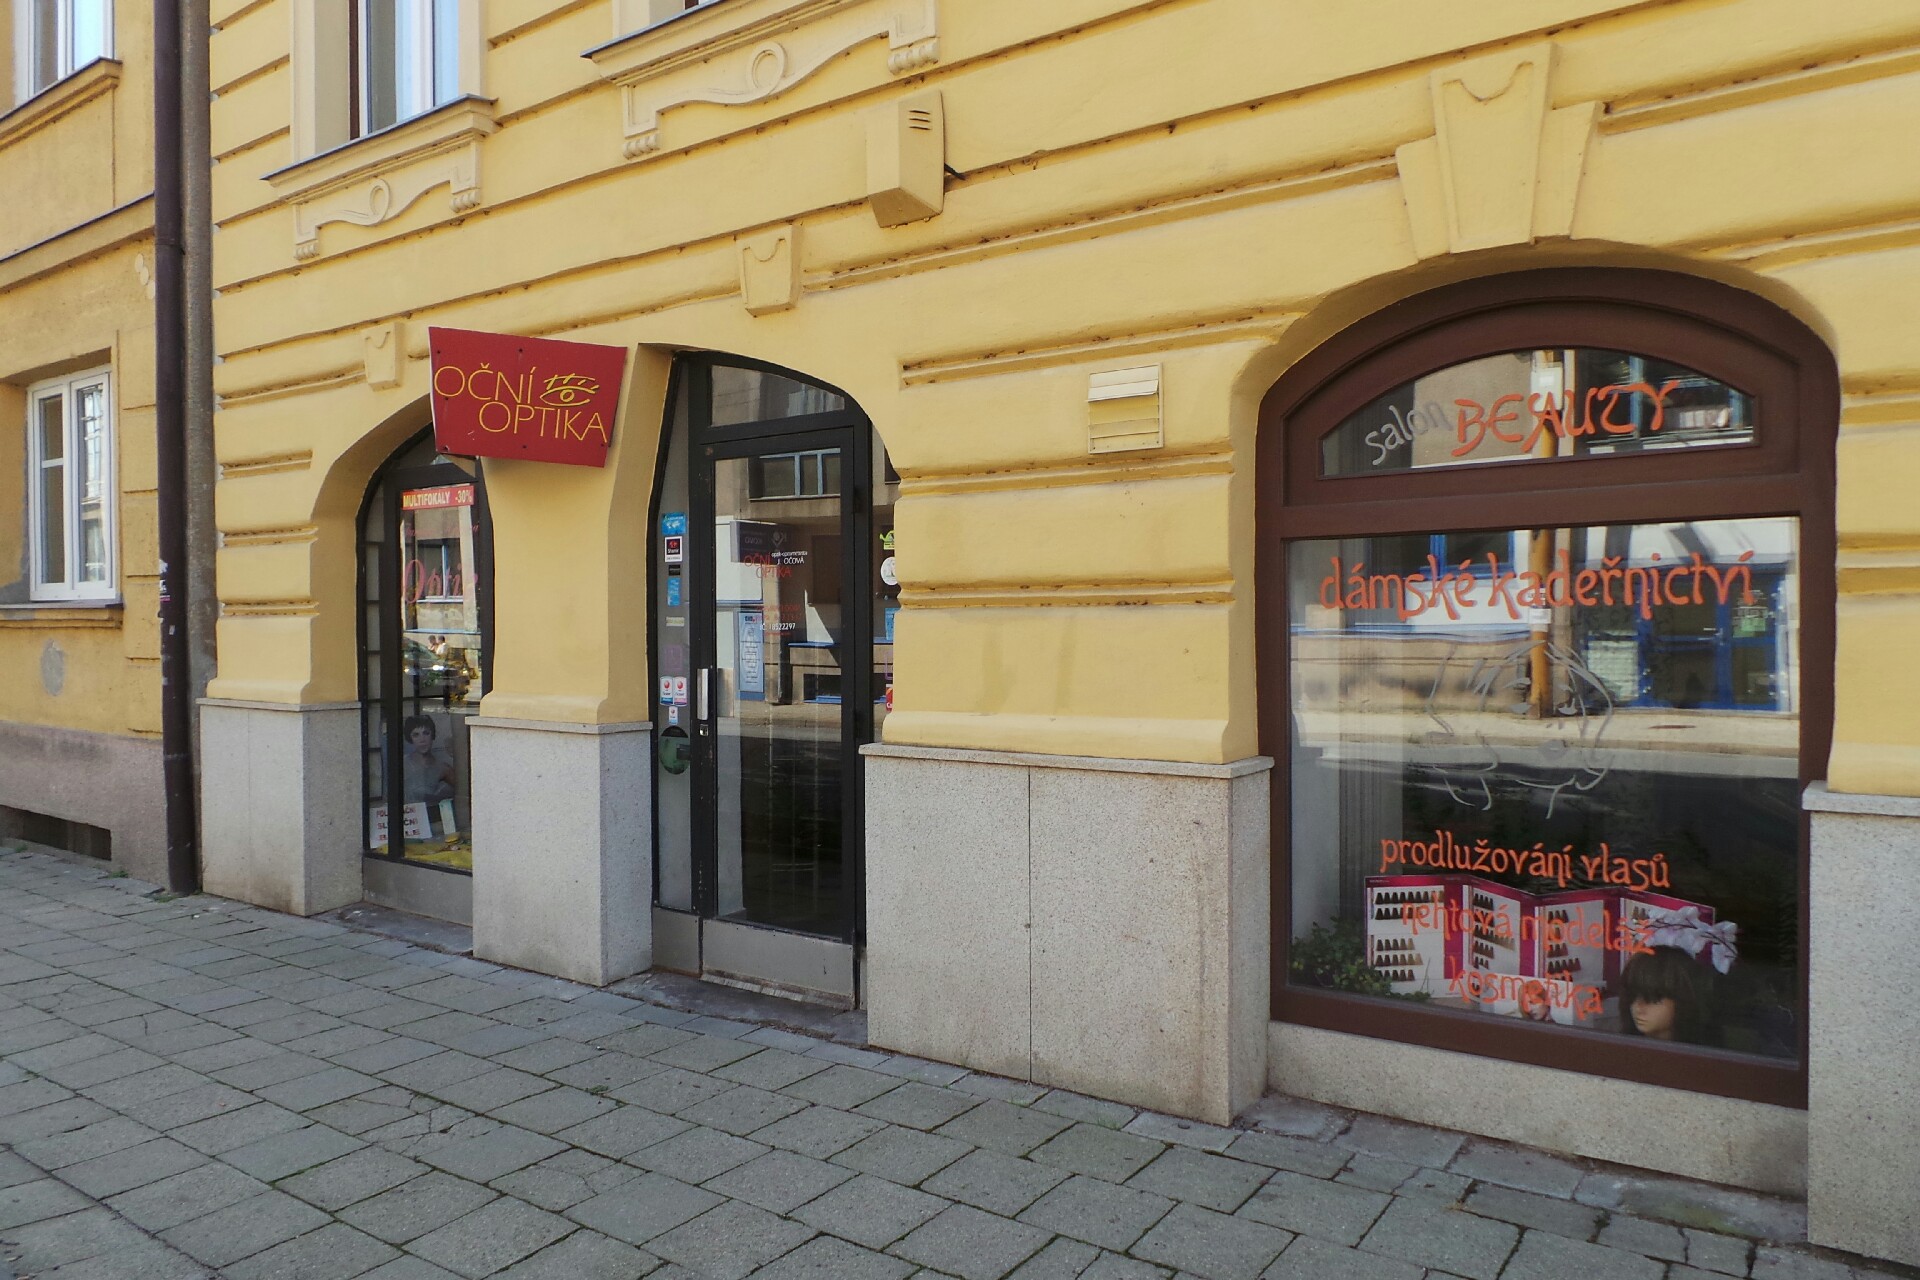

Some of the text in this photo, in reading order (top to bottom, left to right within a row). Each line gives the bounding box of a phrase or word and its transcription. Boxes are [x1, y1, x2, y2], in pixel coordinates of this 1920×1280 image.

[434, 362, 537, 404] OČNÍ
[479, 401, 608, 444] OPTIKA
[1365, 380, 1680, 466] salon BEAUTY
[455, 489, 473, 504] -30%
[744, 552, 772, 567] OČNÍ
[756, 565, 793, 578] OPTIKA
[1319, 549, 1756, 621] dámské kadeřnictví
[1380, 829, 1671, 892] prodlužování vlasů
[1402, 890, 1514, 941] nehtová
